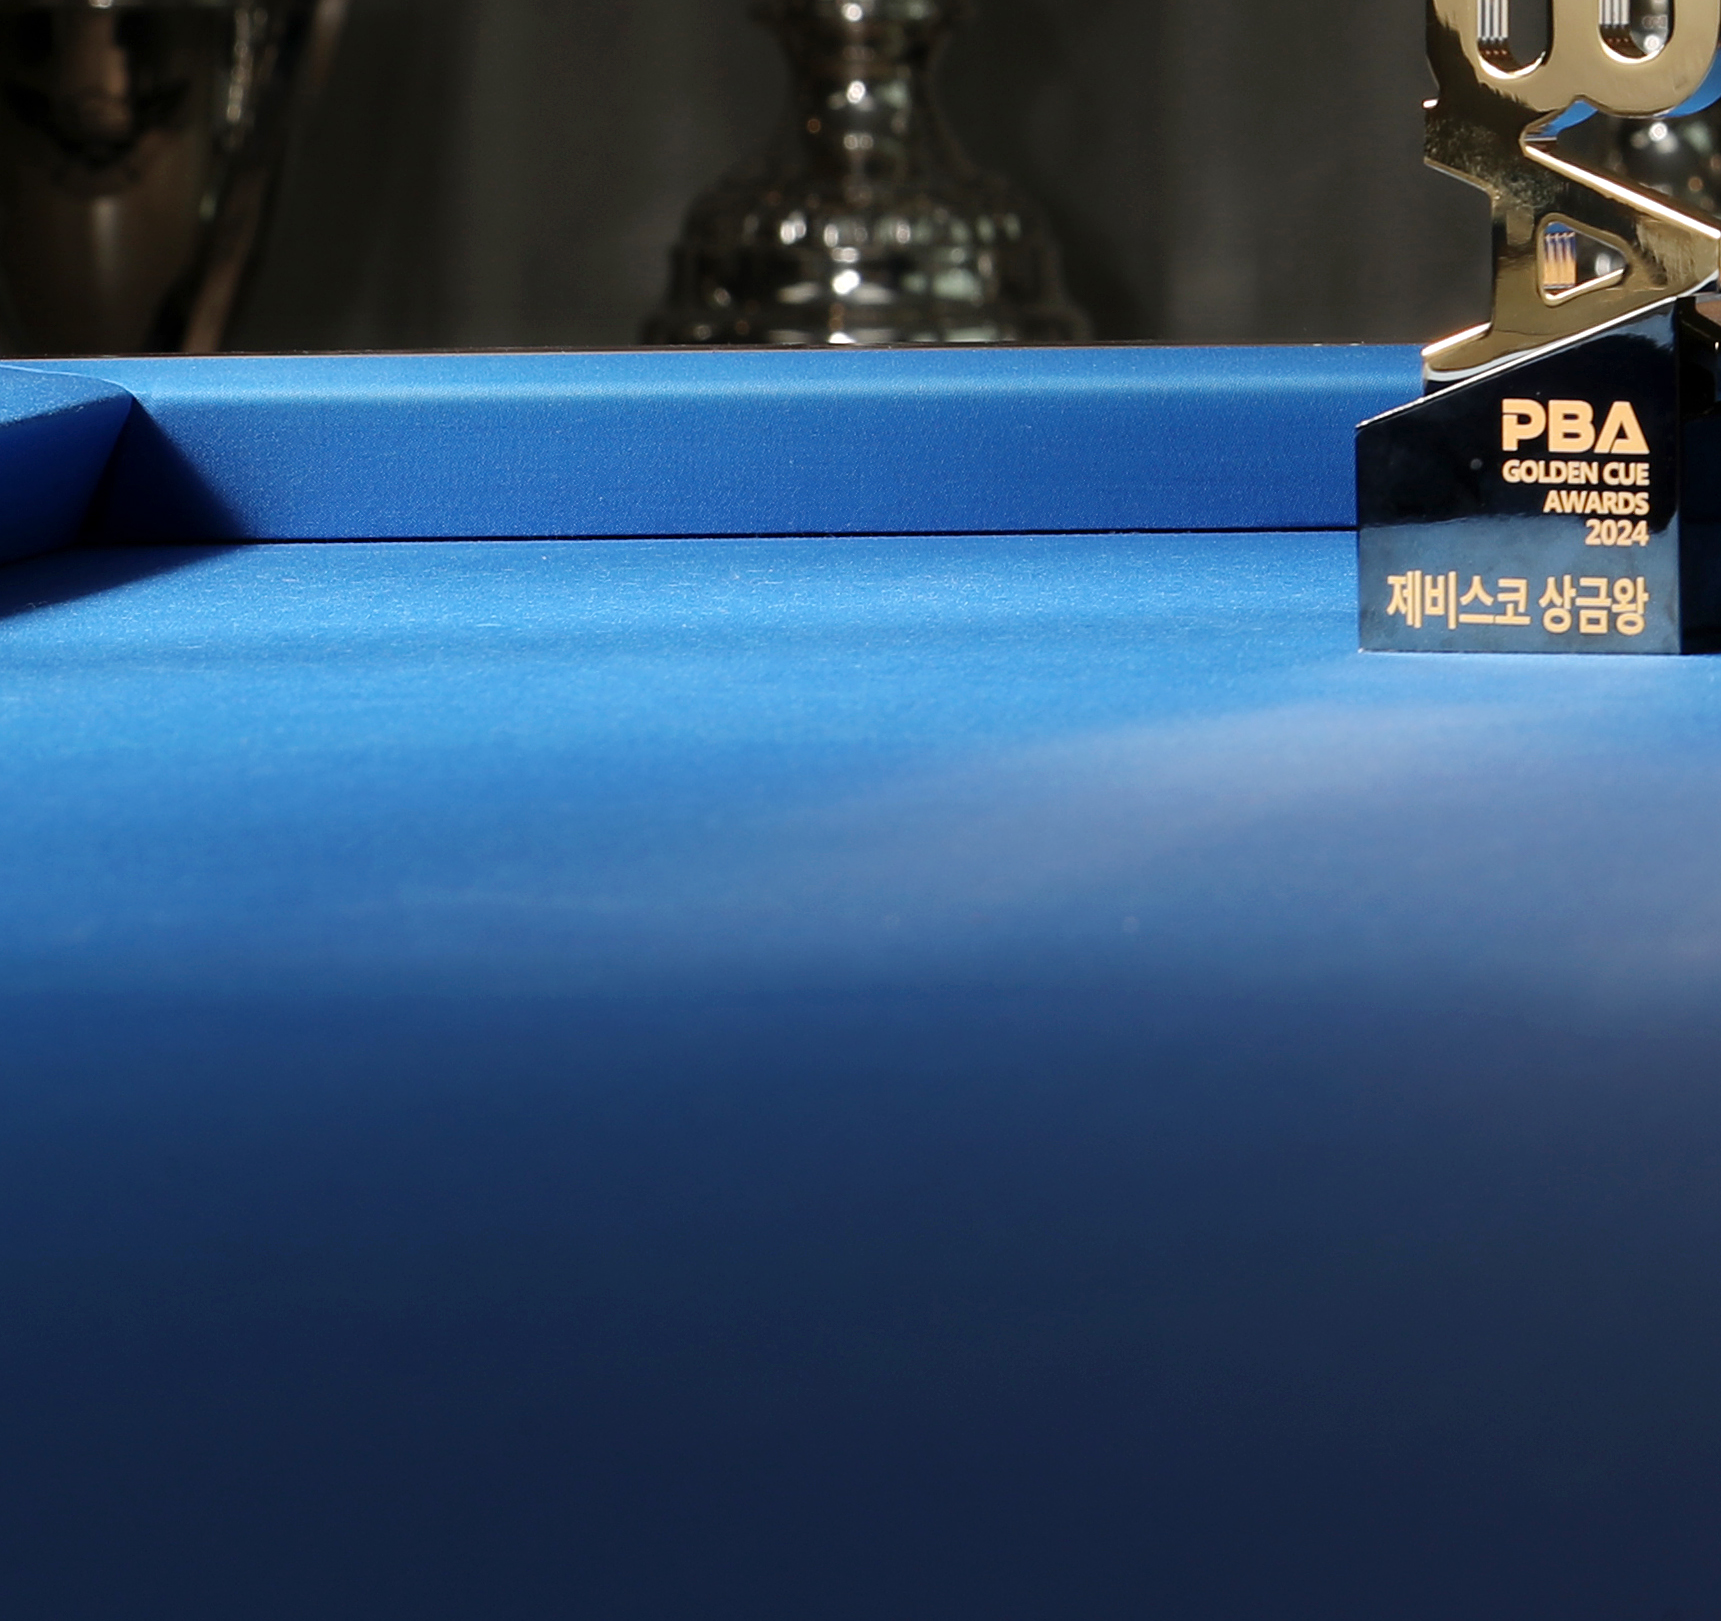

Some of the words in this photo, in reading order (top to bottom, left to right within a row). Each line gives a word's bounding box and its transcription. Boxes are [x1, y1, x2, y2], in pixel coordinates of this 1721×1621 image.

[1502, 399, 1650, 455] PBA
[1502, 459, 1599, 486] GOLDEN
[1602, 459, 1650, 486] CUE
[1543, 490, 1650, 516] AWARDS
[1586, 519, 1650, 547] 2024
[1387, 572, 1531, 630] 제비스코
[1539, 575, 1650, 636] 상금왕
